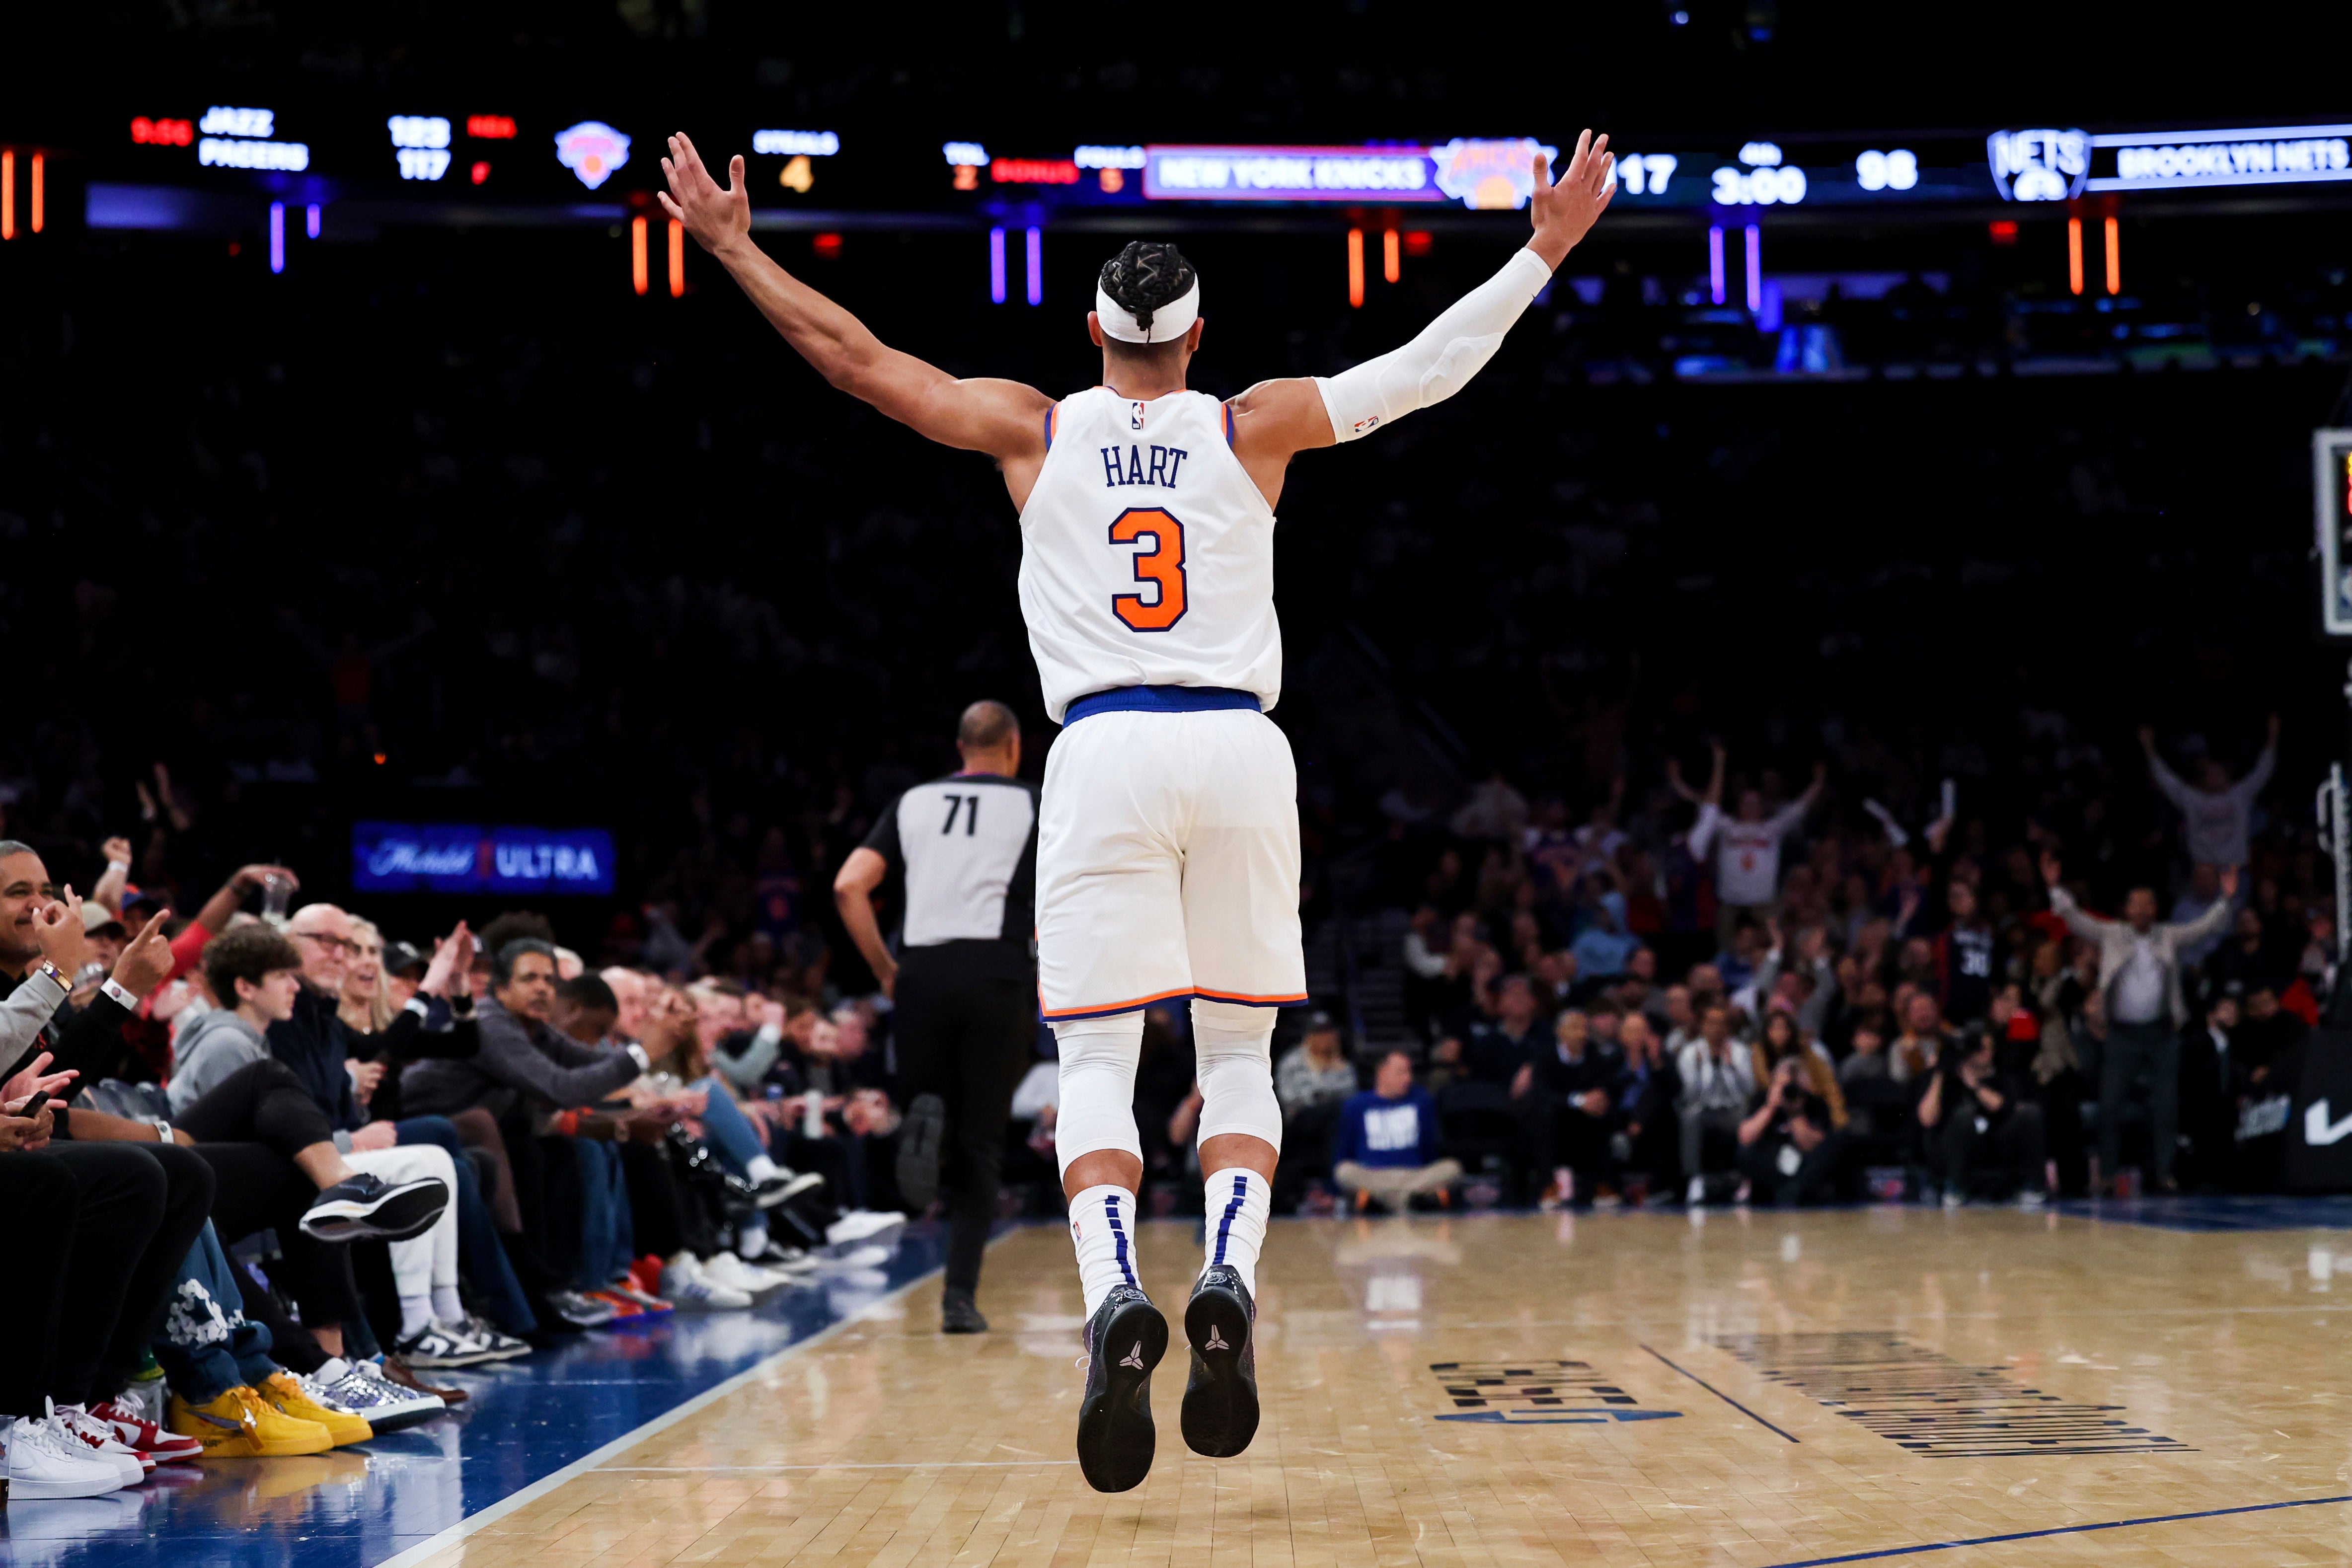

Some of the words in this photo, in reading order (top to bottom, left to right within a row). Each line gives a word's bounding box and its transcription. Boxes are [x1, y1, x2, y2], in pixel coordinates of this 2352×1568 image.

[200, 106, 274, 138] JAZZ
[388, 115, 451, 149] 123
[199, 138, 309, 171] PACERS
[753, 130, 839, 155] STEALS
[1994, 129, 2086, 178] NETS
[2118, 145, 2274, 179] BROOKLYN
[2275, 139, 2350, 172] NETS
[397, 149, 451, 181] 117
[780, 155, 814, 192] 4
[1159, 157, 1231, 189] NEW
[1229, 157, 1312, 189] YORK
[1313, 157, 1426, 190] KNICKS
[1856, 149, 1918, 191] 98
[1712, 166, 1807, 205] 3:00
[1101, 445, 1188, 488] HART
[1108, 507, 1188, 632] 3
[942, 795, 979, 835] 71
[496, 844, 599, 880] ULTRA
